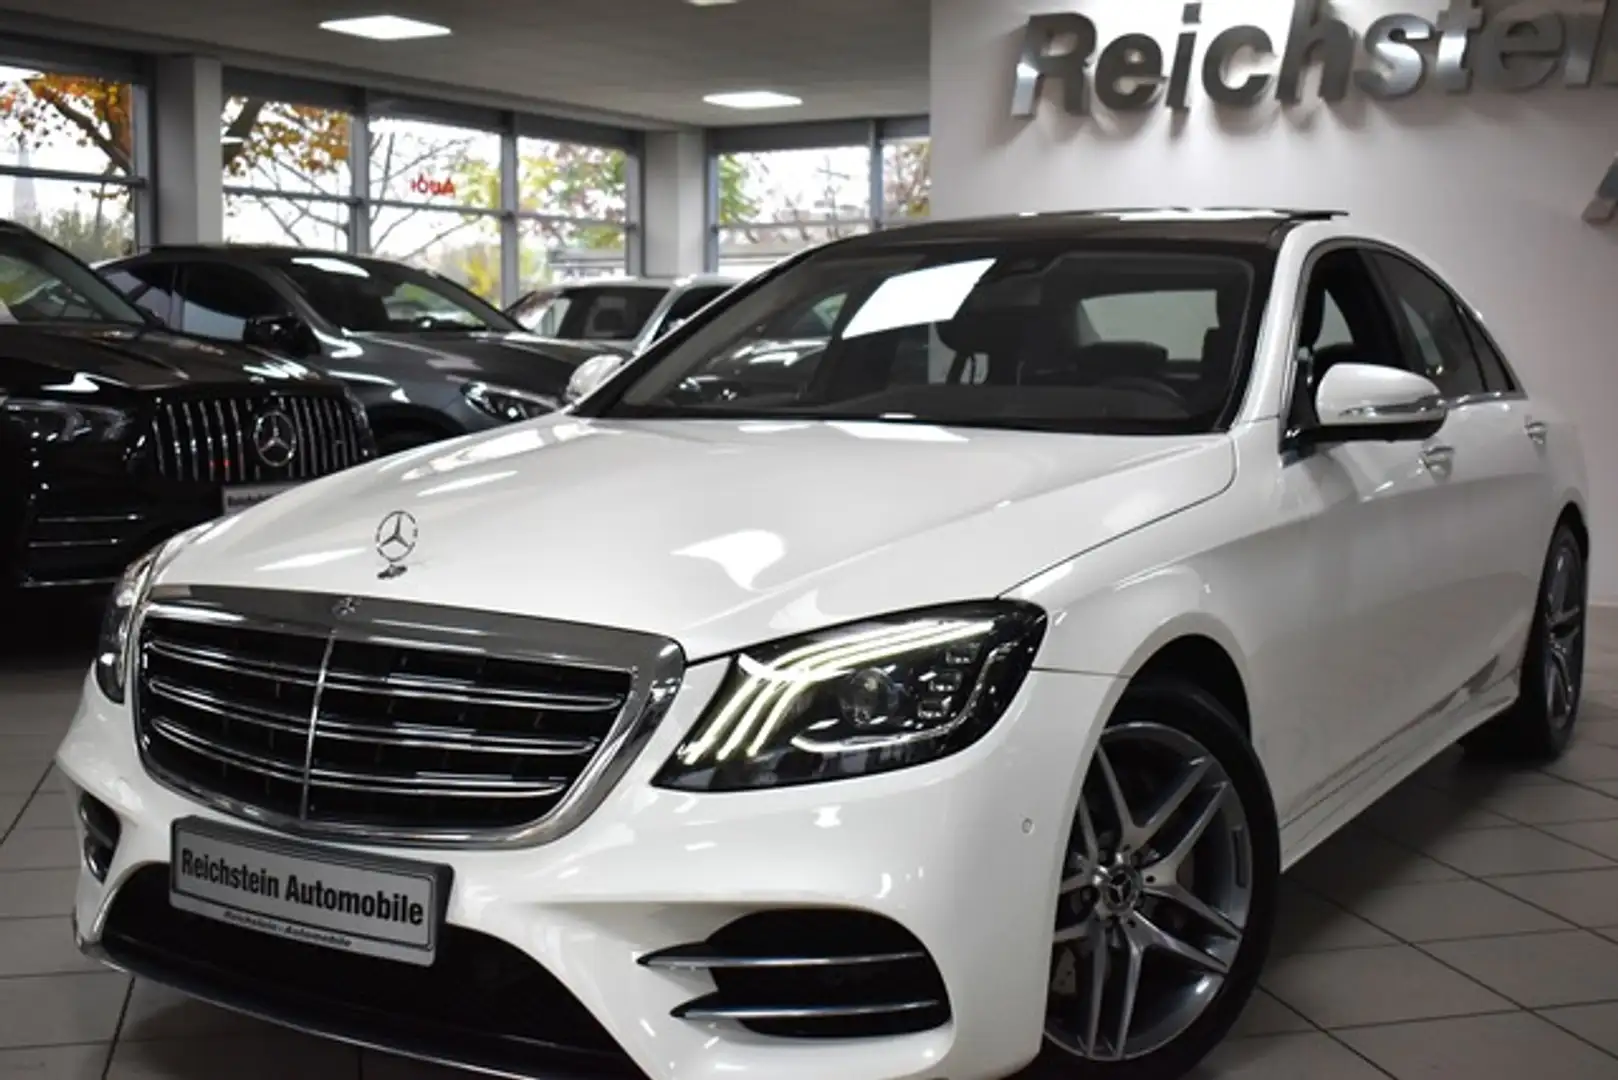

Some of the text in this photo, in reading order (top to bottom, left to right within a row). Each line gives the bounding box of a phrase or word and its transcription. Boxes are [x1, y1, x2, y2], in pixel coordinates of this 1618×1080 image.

[1011, 0, 1618, 118] Reichstei
[181, 847, 424, 926] Reichstein Automobile
